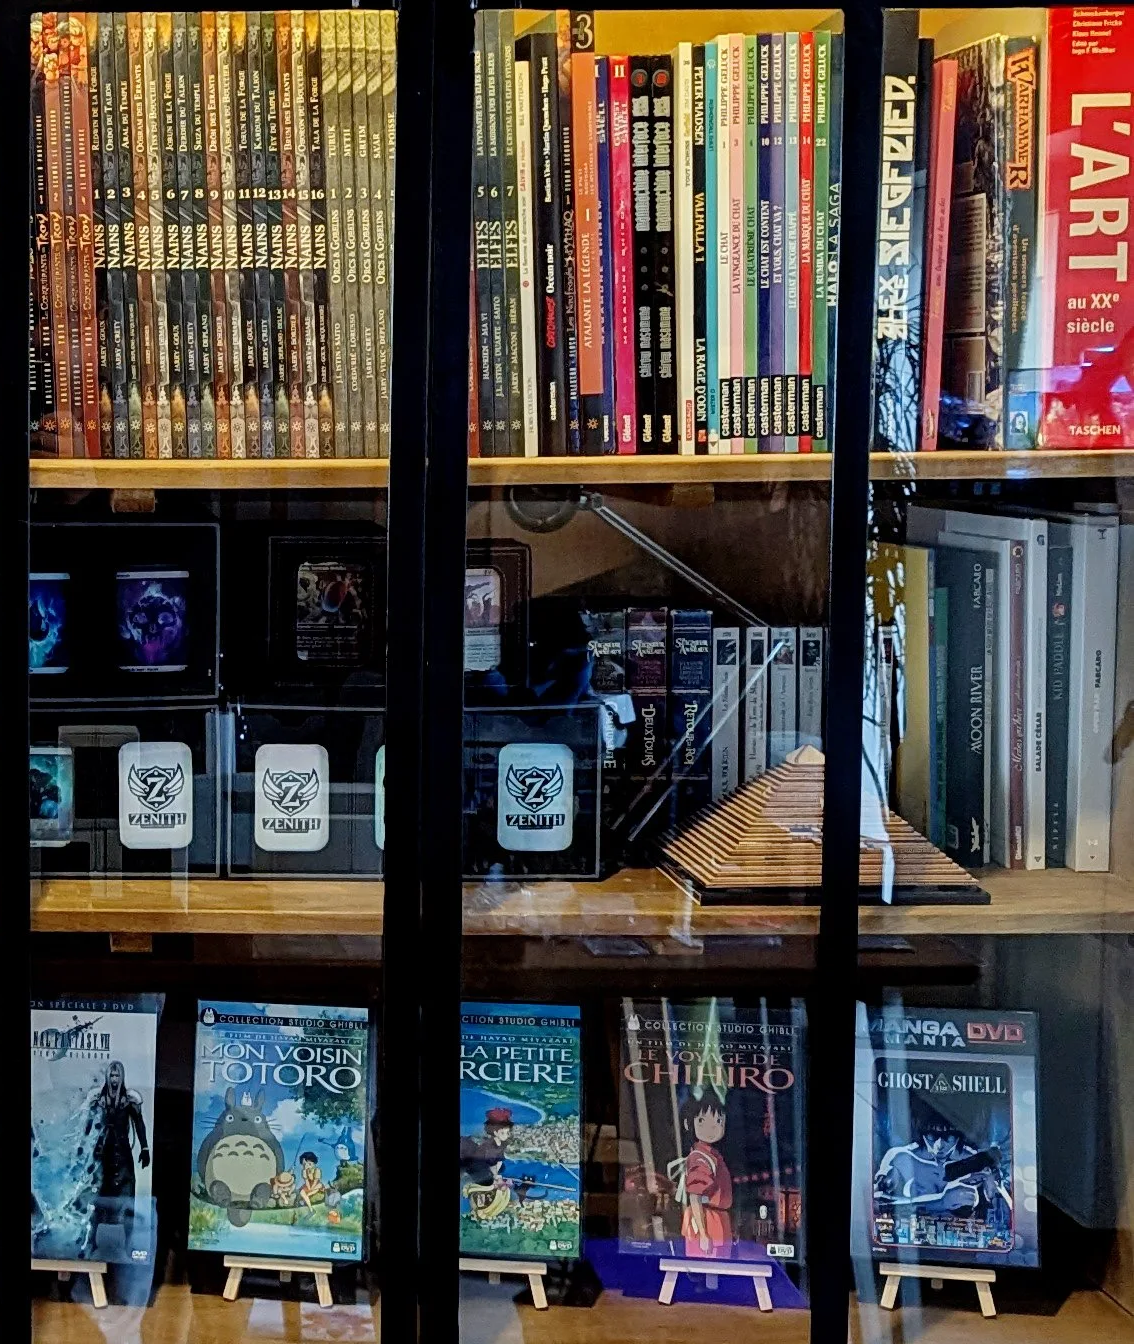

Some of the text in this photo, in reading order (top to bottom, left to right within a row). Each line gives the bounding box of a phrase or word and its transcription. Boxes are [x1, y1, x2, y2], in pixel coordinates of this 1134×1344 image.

[694, 66, 704, 99] PETER
[720, 48, 728, 127] PHILIPPE GELUCK
[761, 45, 769, 124] PHILIPPE GELUCK
[802, 44, 811, 123] PHILIPPE GELUCK
[694, 101, 705, 146] MADSEN
[1009, 55, 1035, 185] WARHAMMER
[120, 81, 131, 198] 3 TEMPLE
[311, 129, 324, 199] 16 TALA
[94, 189, 100, 199] 1
[107, 188, 115, 199] 2
[137, 191, 146, 200] 4
[167, 189, 175, 199] 6
[194, 189, 204, 199] 8
[239, 189, 250, 199] 11
[253, 188, 266, 198] 12
[331, 188, 336, 199] 1
[345, 188, 352, 198] 2
[374, 189, 381, 199] 4
[477, 186, 484, 197] 5
[490, 187, 498, 198] 6
[506, 186, 514, 196] 7
[1068, 92, 1131, 282] L'ART
[694, 192, 705, 253] VALHALLA
[816, 210, 825, 235] CHAT
[93, 224, 105, 268] NAINS
[107, 224, 120, 269] NAINS
[123, 222, 135, 267] NAINS
[138, 225, 150, 271] NAINS
[167, 224, 180, 269] NAINS
[196, 223, 208, 268] NAINS
[241, 224, 253, 268] NAINS
[313, 224, 326, 270] NAINS
[330, 210, 341, 284] ORCS GOBELINS
[375, 210, 386, 284] ORCS GOBELINS
[476, 221, 490, 269] ELFES
[489, 221, 502, 269] ELFES
[505, 220, 518, 268] ELFES
[720, 232, 728, 265] LE CHAT
[732, 198, 741, 294] LA CHAT
[545, 244, 554, 293] Océan noir
[580, 232, 592, 348] ATALANTE LA LÉGENDE
[1067, 296, 1086, 310] au
[1067, 319, 1115, 334] siècle
[696, 338, 706, 383] LA RAGE
[721, 381, 730, 436] casterman
[732, 379, 741, 436] casterman
[746, 379, 755, 436] casterman
[760, 377, 769, 436] casterman
[1069, 425, 1121, 435] TASCHEN
[1053, 680, 1063, 700] KID
[970, 665, 982, 754] MOON RIVER
[128, 813, 187, 825] ZENITH
[261, 818, 321, 830] ZENITH
[505, 814, 565, 827] ZENITH
[219, 1015, 363, 1029] COLLECTION STUDIO GHIBLI
[499, 1017, 575, 1027] STUDIO GHIBLI
[717, 1024, 754, 1033] STUDIO
[759, 1026, 795, 1035] GHIBLI
[967, 1022, 1026, 1043] DVD
[201, 1043, 362, 1065] MON VOISIN
[460, 1045, 573, 1062] LA PETITE
[638, 1049, 658, 1060] LE
[752, 1054, 780, 1065] DE
[202, 1060, 362, 1095] TOTORO
[460, 1061, 575, 1084] RCIÈRE
[624, 1062, 795, 1094] CHIHIRO
[878, 1072, 1006, 1094] GHOST SHELL
